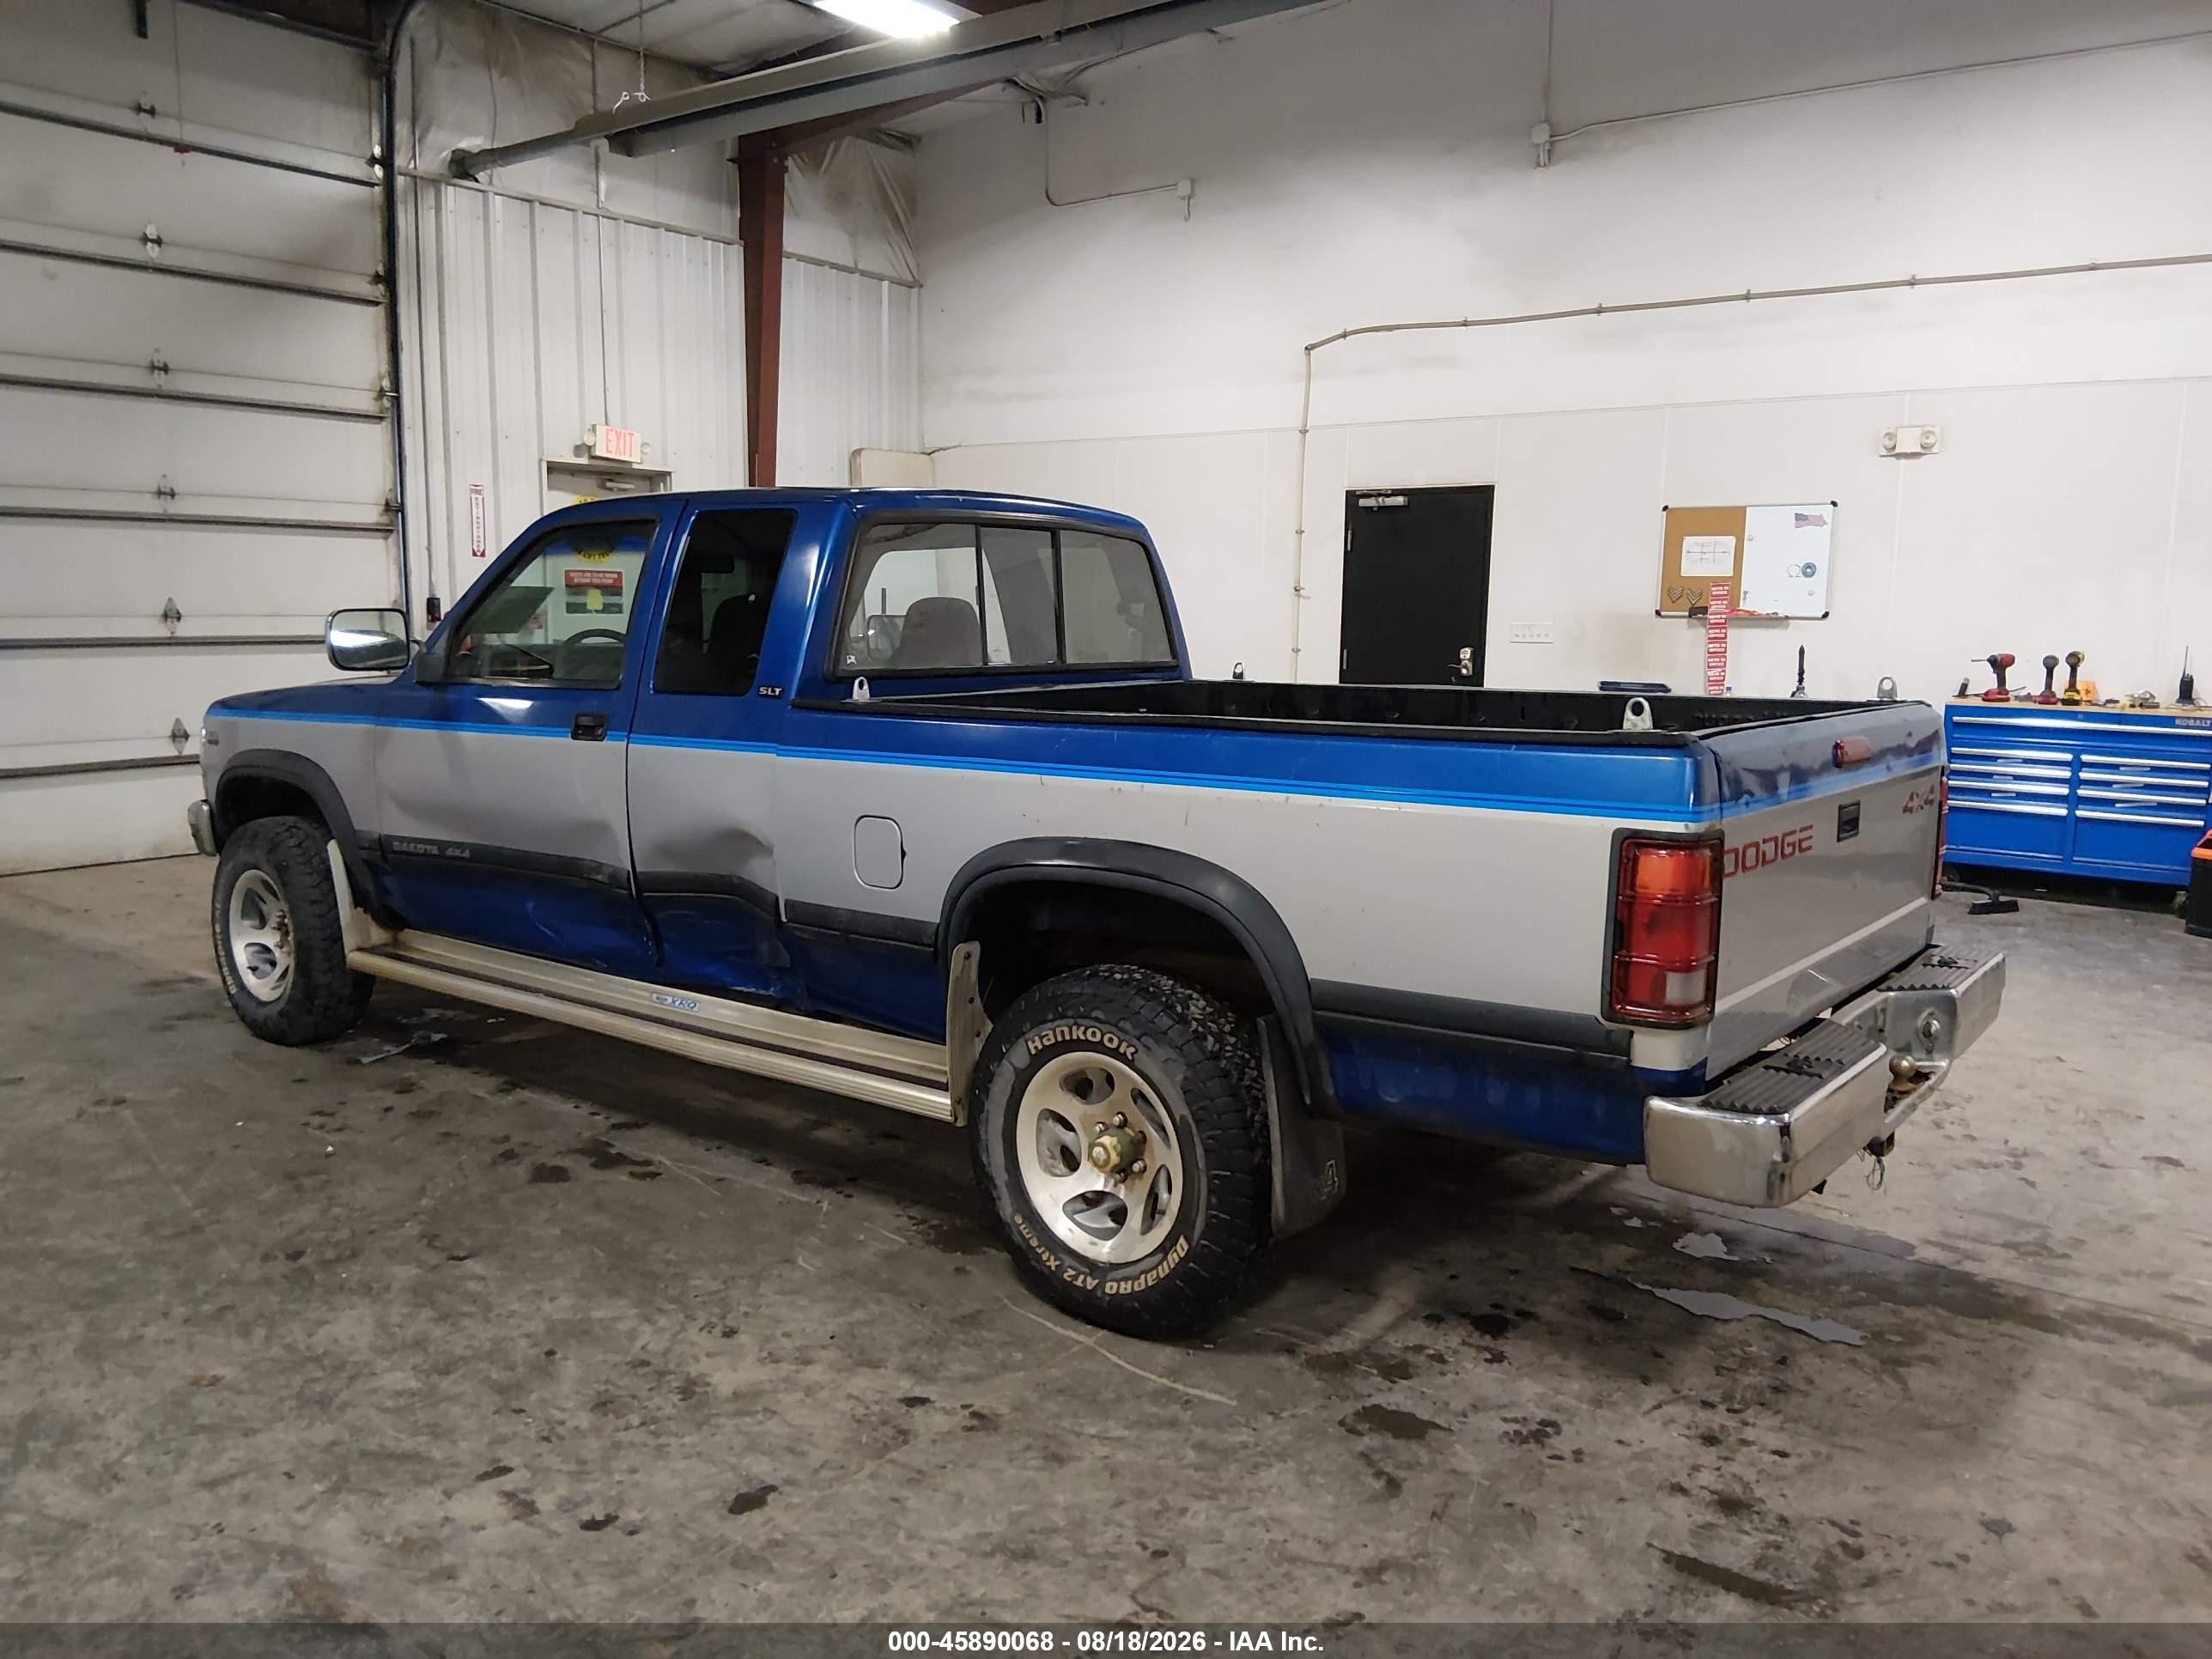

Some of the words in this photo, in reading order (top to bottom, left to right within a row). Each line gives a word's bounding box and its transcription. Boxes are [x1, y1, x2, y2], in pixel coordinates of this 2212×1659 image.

[605, 428, 634, 458] EXIT
[758, 686, 782, 696] SLT
[1723, 824, 1814, 878] DODGE
[1013, 1214, 1060, 1271] Xtreme
[1063, 1267, 1099, 1290] AT2
